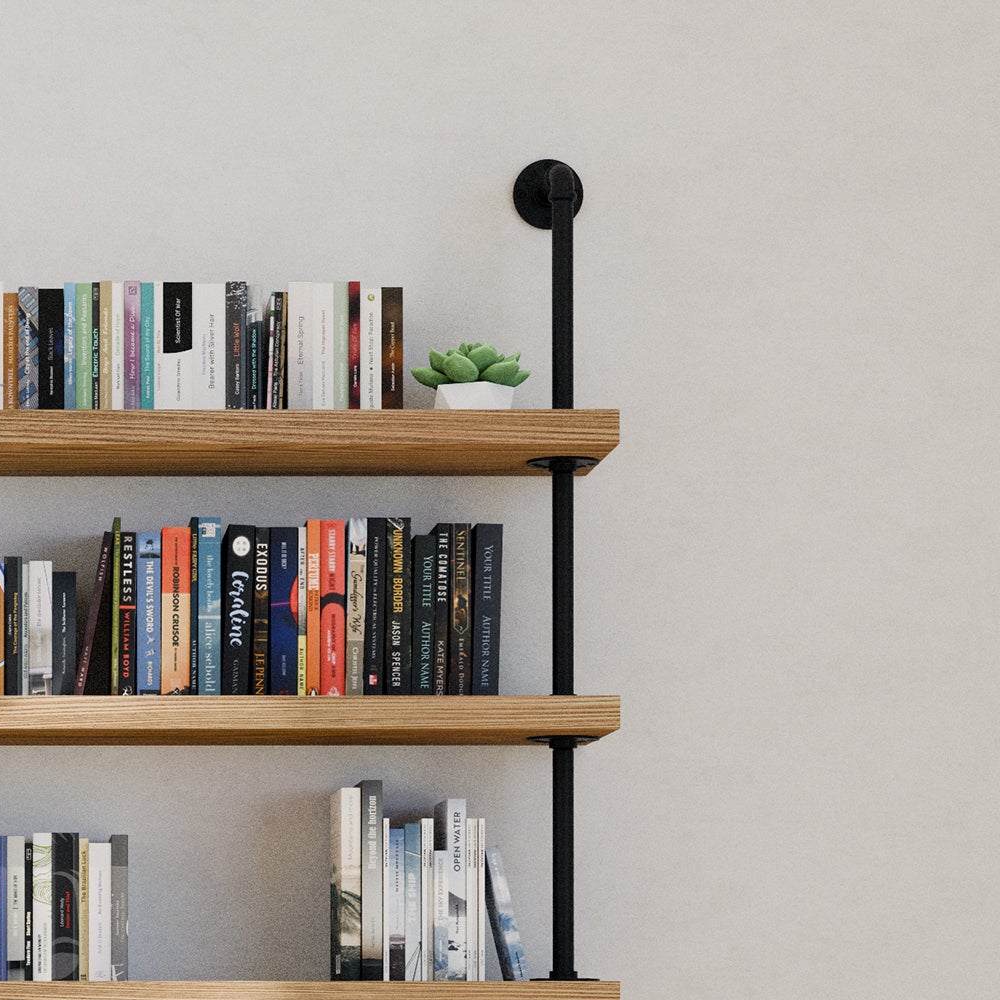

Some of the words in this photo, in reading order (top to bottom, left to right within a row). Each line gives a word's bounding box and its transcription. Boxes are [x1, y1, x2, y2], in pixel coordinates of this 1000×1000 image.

[393, 530, 403, 573] UNKNOWN
[439, 533, 448, 549] THE
[98, 547, 107, 581] WOLFISH
[123, 536, 132, 602] RESTLESS
[146, 561, 154, 575] THE
[256, 544, 267, 590] EXODUS
[423, 556, 433, 581] YOUR
[456, 530, 466, 582] SENTINEL
[483, 545, 493, 572] YOUR
[308, 553, 319, 590] PERFUME
[437, 554, 448, 602] COMATOSE
[146, 576, 154, 603] DEVIL'S
[350, 571, 363, 612] Gumdigger's
[393, 578, 403, 613] BORDER
[422, 584, 432, 607] TITLE
[483, 575, 491, 600] TITLE
[146, 604, 154, 633] SWORD
[229, 571, 249, 647] Coraline
[205, 622, 215, 649] alice
[350, 615, 360, 634] Wife
[392, 621, 400, 645] JASON
[481, 615, 491, 656] AUTHOR
[421, 621, 431, 660] AUTHOR
[437, 640, 445, 663] KATE
[205, 653, 215, 692] sebold
[392, 652, 401, 687] SPENCER
[420, 663, 429, 689] NAME
[436, 666, 444, 695] MYERS
[481, 659, 489, 687] NAME
[367, 795, 377, 825] horizon
[368, 826, 377, 839] the
[453, 812, 461, 843] WATER
[368, 841, 378, 869] Beyond
[453, 846, 461, 872] OPEN
